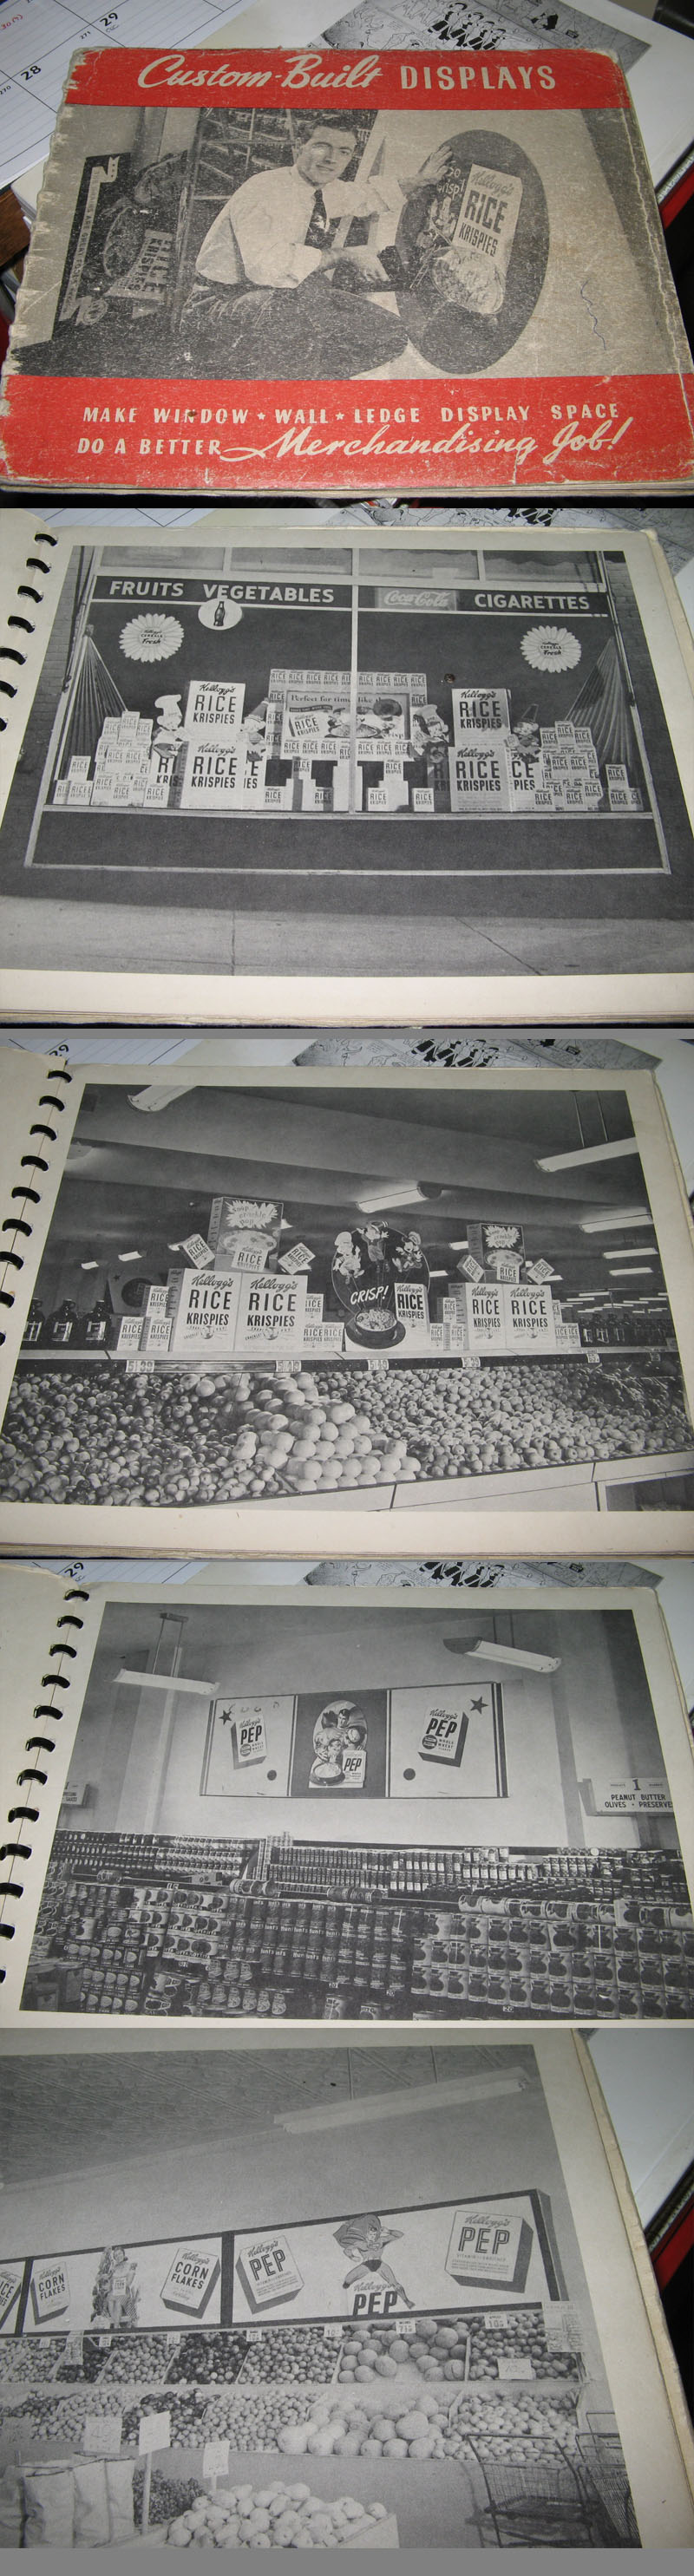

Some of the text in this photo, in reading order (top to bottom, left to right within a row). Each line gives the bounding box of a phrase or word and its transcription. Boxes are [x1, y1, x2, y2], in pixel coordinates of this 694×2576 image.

[100, 12, 118, 27] 29
[21, 65, 42, 81] 28
[137, 54, 556, 90] Custom-Built DISPLAYS
[471, 171, 514, 197] Kellogg's
[464, 190, 508, 234] RICE
[458, 222, 498, 257] KRISPIES
[82, 403, 620, 424] MAKE WINDOW WALL LEDGE DISPLAY SPACE
[77, 416, 634, 465] DO A BETTER Merchandising Job!
[109, 580, 335, 603] FRUITS VEGETABLES
[383, 590, 590, 610] Coca-Cola CIGARETTES
[200, 683, 236, 696] Kellogg's
[460, 690, 497, 701] Kellogg's
[194, 695, 237, 713] RICE
[459, 701, 501, 718] RICE
[193, 712, 235, 724] KRISPIES
[295, 717, 318, 730] RICE
[460, 718, 502, 729] KRISPIES
[197, 742, 236, 757] Kellogg's
[456, 748, 495, 760] Kellogg's
[71, 761, 88, 769] RICE
[193, 756, 238, 776] RICE
[455, 761, 501, 779] RICE
[191, 776, 236, 789] KRISPIES
[456, 780, 501, 792] KRISPIES
[114, 787, 130, 795] RICE
[147, 788, 165, 796] RICE
[188, 1240, 205, 1256] RICE
[291, 1247, 309, 1264] RICE
[238, 1252, 263, 1265] RICE
[500, 1267, 517, 1277] RICE
[537, 1263, 550, 1275] RICE
[191, 1273, 233, 1290] Kellogg's
[250, 1277, 298, 1292] Kellogg's
[350, 1285, 390, 1304] CRISP!
[396, 1284, 423, 1295] Kellogg's
[472, 1286, 498, 1298] Kellogg's
[510, 1287, 545, 1300] Kellogg's
[151, 1293, 168, 1302] RICE
[188, 1289, 232, 1310] RICE
[248, 1292, 297, 1311] RICE
[397, 1293, 424, 1311] RICE
[472, 1299, 500, 1315] RICE
[511, 1300, 547, 1315] RICE
[187, 1312, 230, 1325] KRISPIES
[247, 1314, 295, 1327] KRISPIES
[398, 1311, 425, 1319] KRISPIES
[122, 1324, 142, 1334] RICE
[151, 1324, 170, 1334] RICE
[474, 1318, 501, 1328] KRISPIES
[513, 1318, 548, 1328] KRISPIES
[64, 1562, 83, 1577] 29
[429, 1709, 458, 1721] Kellogg's
[240, 1724, 262, 1745] PEP
[425, 1718, 457, 1738] PEP
[344, 1758, 362, 1772] PEP
[632, 1779, 641, 1791] 1
[465, 2214, 511, 2228] Kellogg's
[458, 2226, 510, 2254] PEP
[247, 2240, 278, 2258] Kellogg's
[181, 2252, 210, 2265] Kellogg's
[249, 2249, 285, 2281] PEP
[175, 2261, 209, 2280] CORN
[38, 2273, 64, 2292] CORN
[171, 2273, 205, 2290] FLAKES
[40, 2284, 66, 2300] FLAKES
[352, 2291, 398, 2316] PEP
